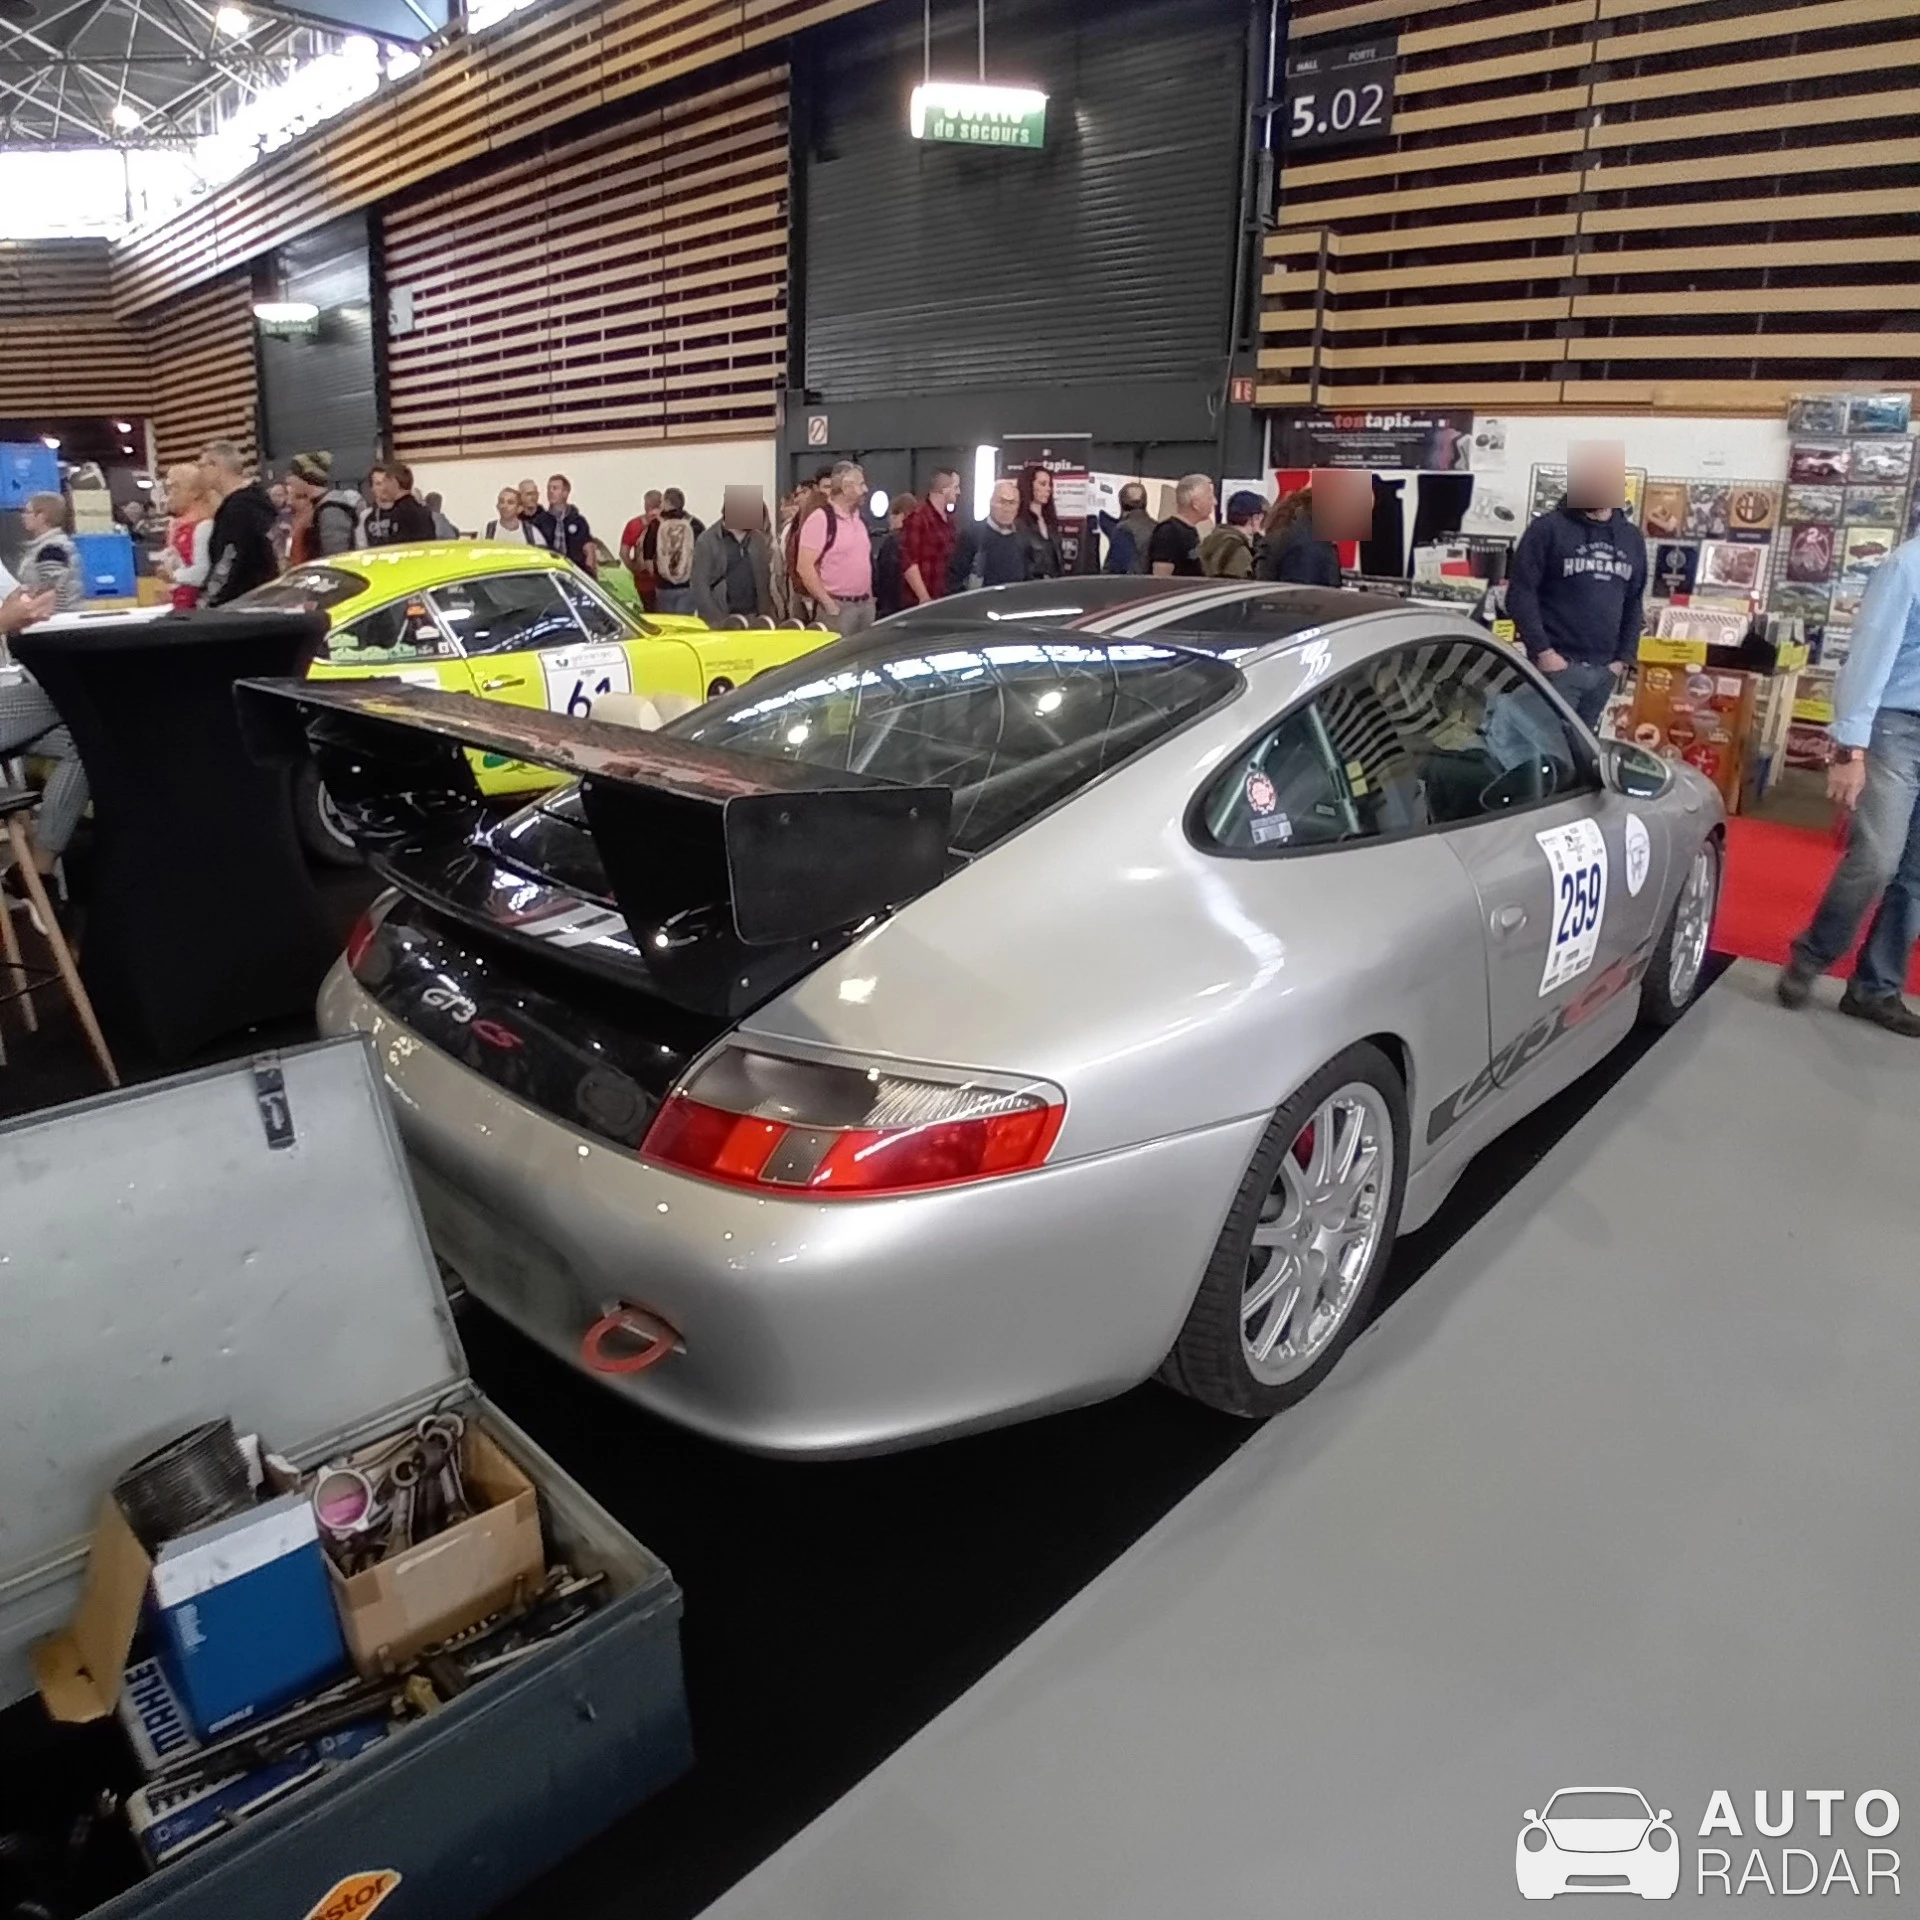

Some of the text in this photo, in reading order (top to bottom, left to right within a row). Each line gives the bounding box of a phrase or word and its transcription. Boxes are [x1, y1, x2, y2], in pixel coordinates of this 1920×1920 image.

[933, 118, 1030, 144] de secours
[1291, 84, 1384, 137] 5.02
[1556, 862, 1602, 946] 259
[421, 986, 478, 1024] GT3
[124, 1662, 189, 1758] MAHLE
